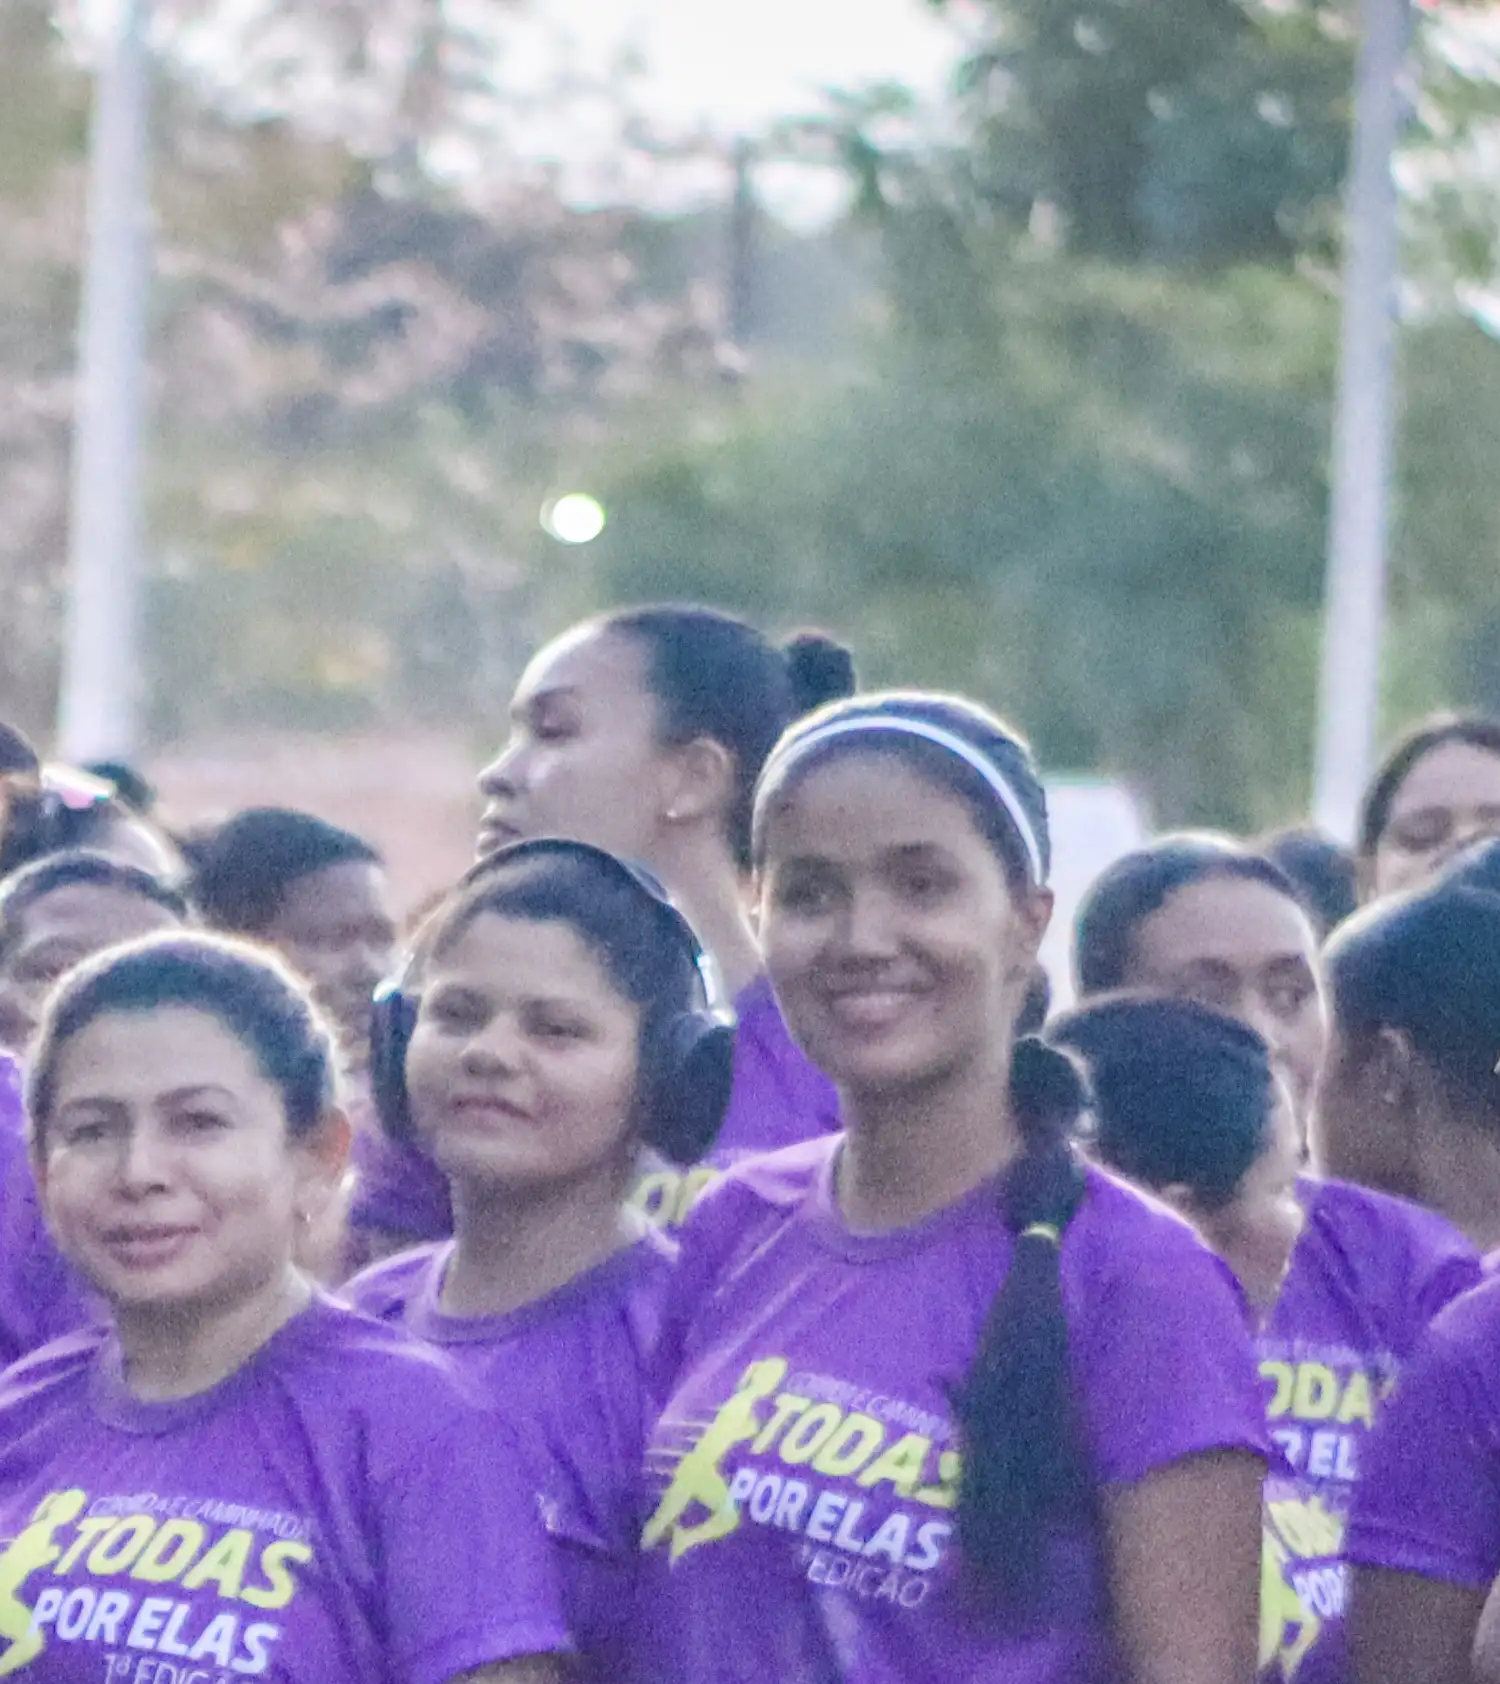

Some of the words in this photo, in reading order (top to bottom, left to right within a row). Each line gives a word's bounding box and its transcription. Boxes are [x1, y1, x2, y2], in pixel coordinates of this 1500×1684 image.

[53, 1515, 312, 1609] TODAS
[729, 1466, 808, 1532] POR
[806, 1490, 952, 1570] ELAS
[28, 1587, 130, 1644] POR
[127, 1597, 281, 1674] ELAS
